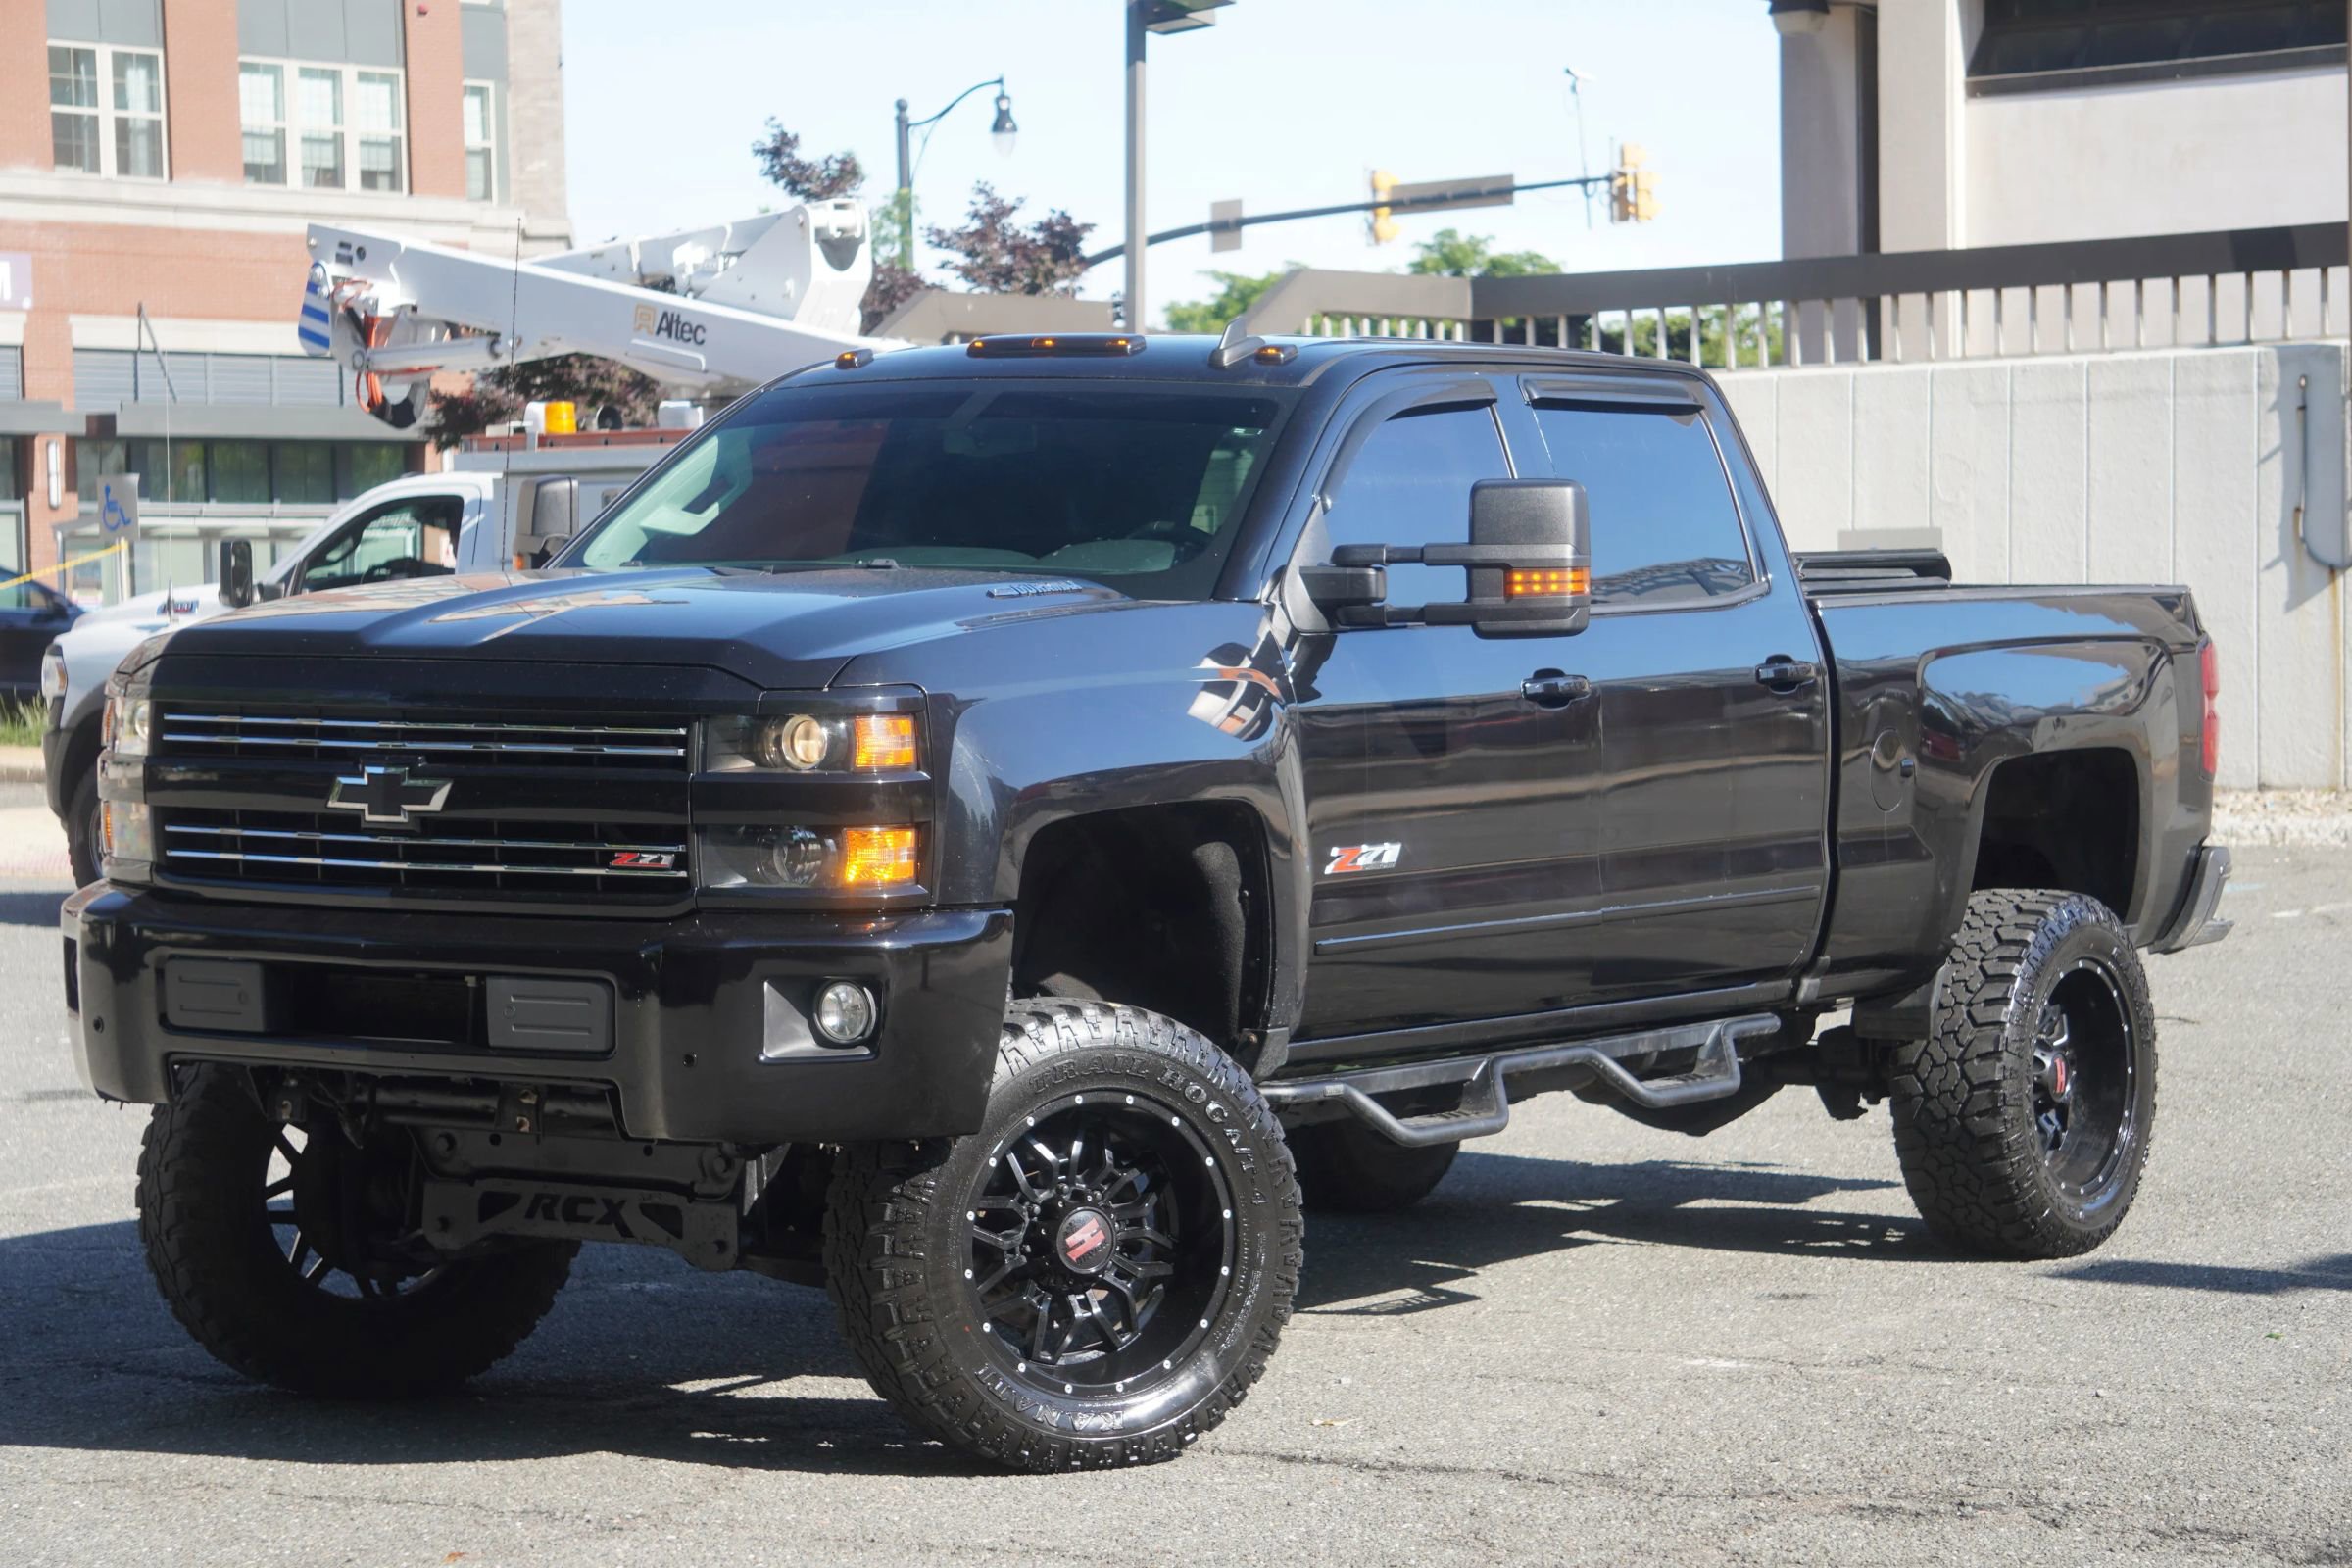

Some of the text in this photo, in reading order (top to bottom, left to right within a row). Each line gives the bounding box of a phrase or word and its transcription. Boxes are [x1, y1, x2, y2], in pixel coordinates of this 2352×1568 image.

[655, 311, 707, 346] Altec
[609, 852, 675, 869] Z71
[1324, 842, 1402, 875] Z71
[1028, 1053, 1150, 1095] TRAIL
[1156, 1059, 1229, 1125] HOG
[523, 1193, 635, 1239] RCX
[974, 1362, 1124, 1432] KANATI
